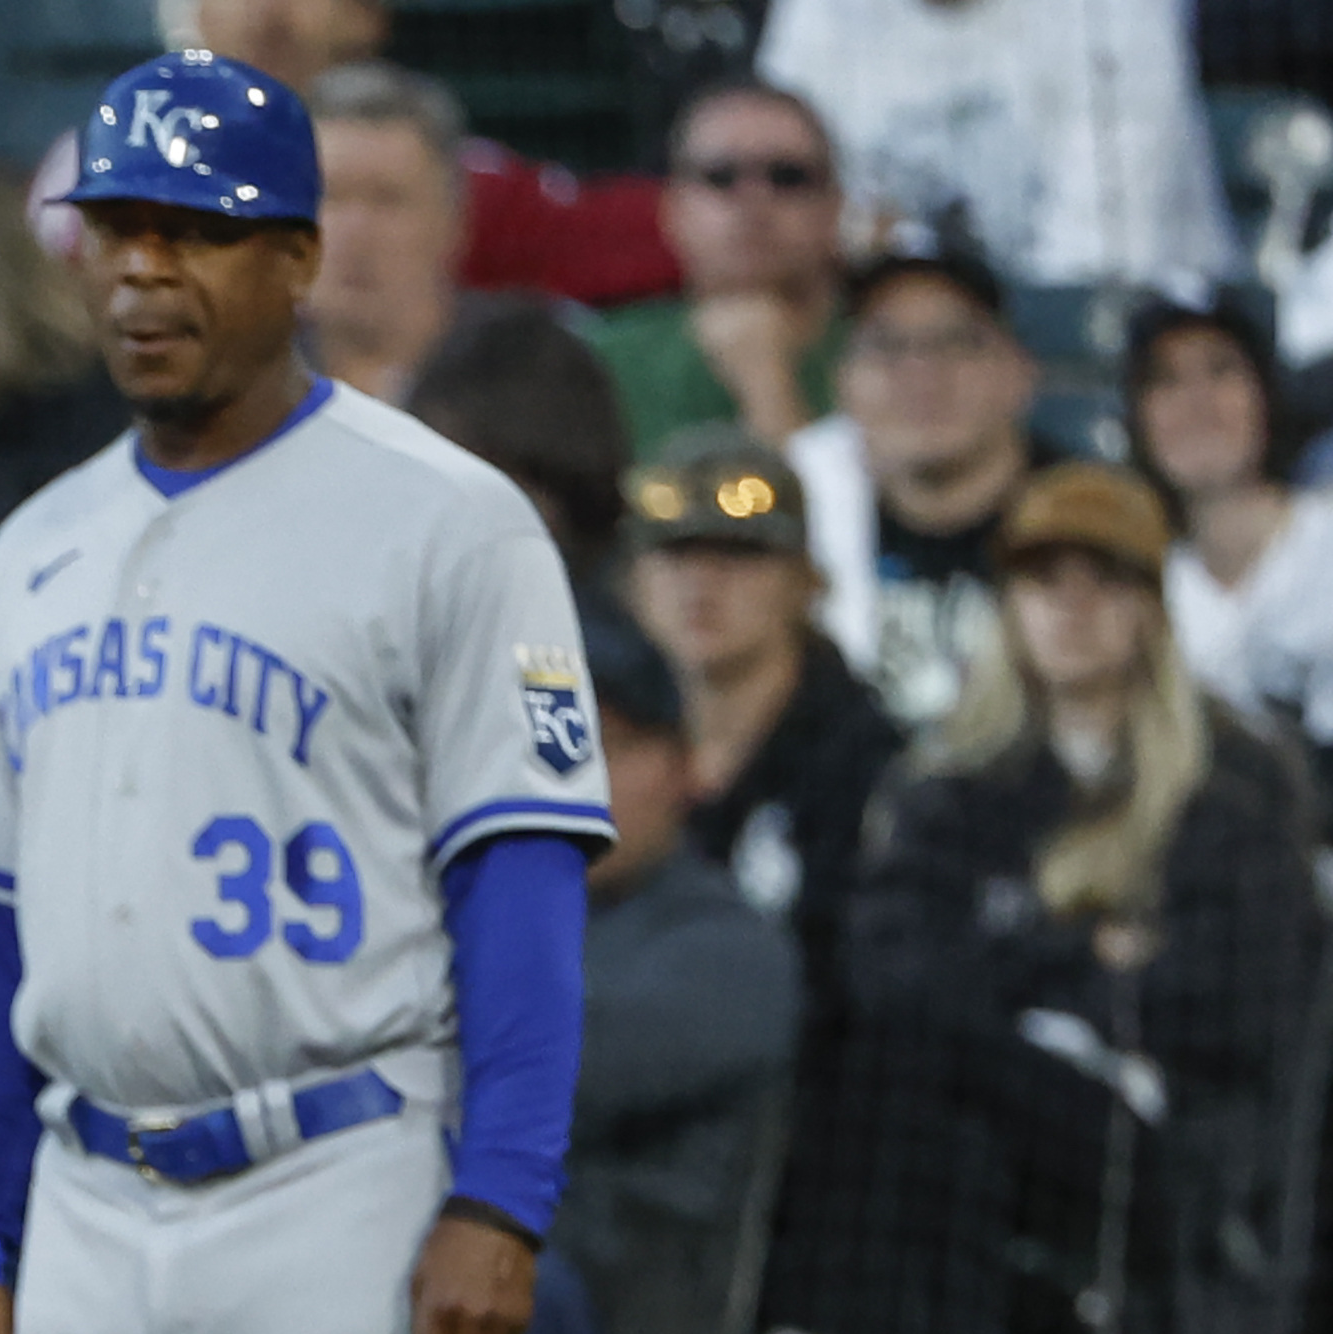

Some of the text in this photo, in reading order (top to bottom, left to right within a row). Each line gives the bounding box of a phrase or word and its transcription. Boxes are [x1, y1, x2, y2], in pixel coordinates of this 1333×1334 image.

[124, 89, 202, 169] KC
[188, 620, 329, 769] CITY
[523, 690, 592, 762] KC
[190, 814, 364, 965] 39
